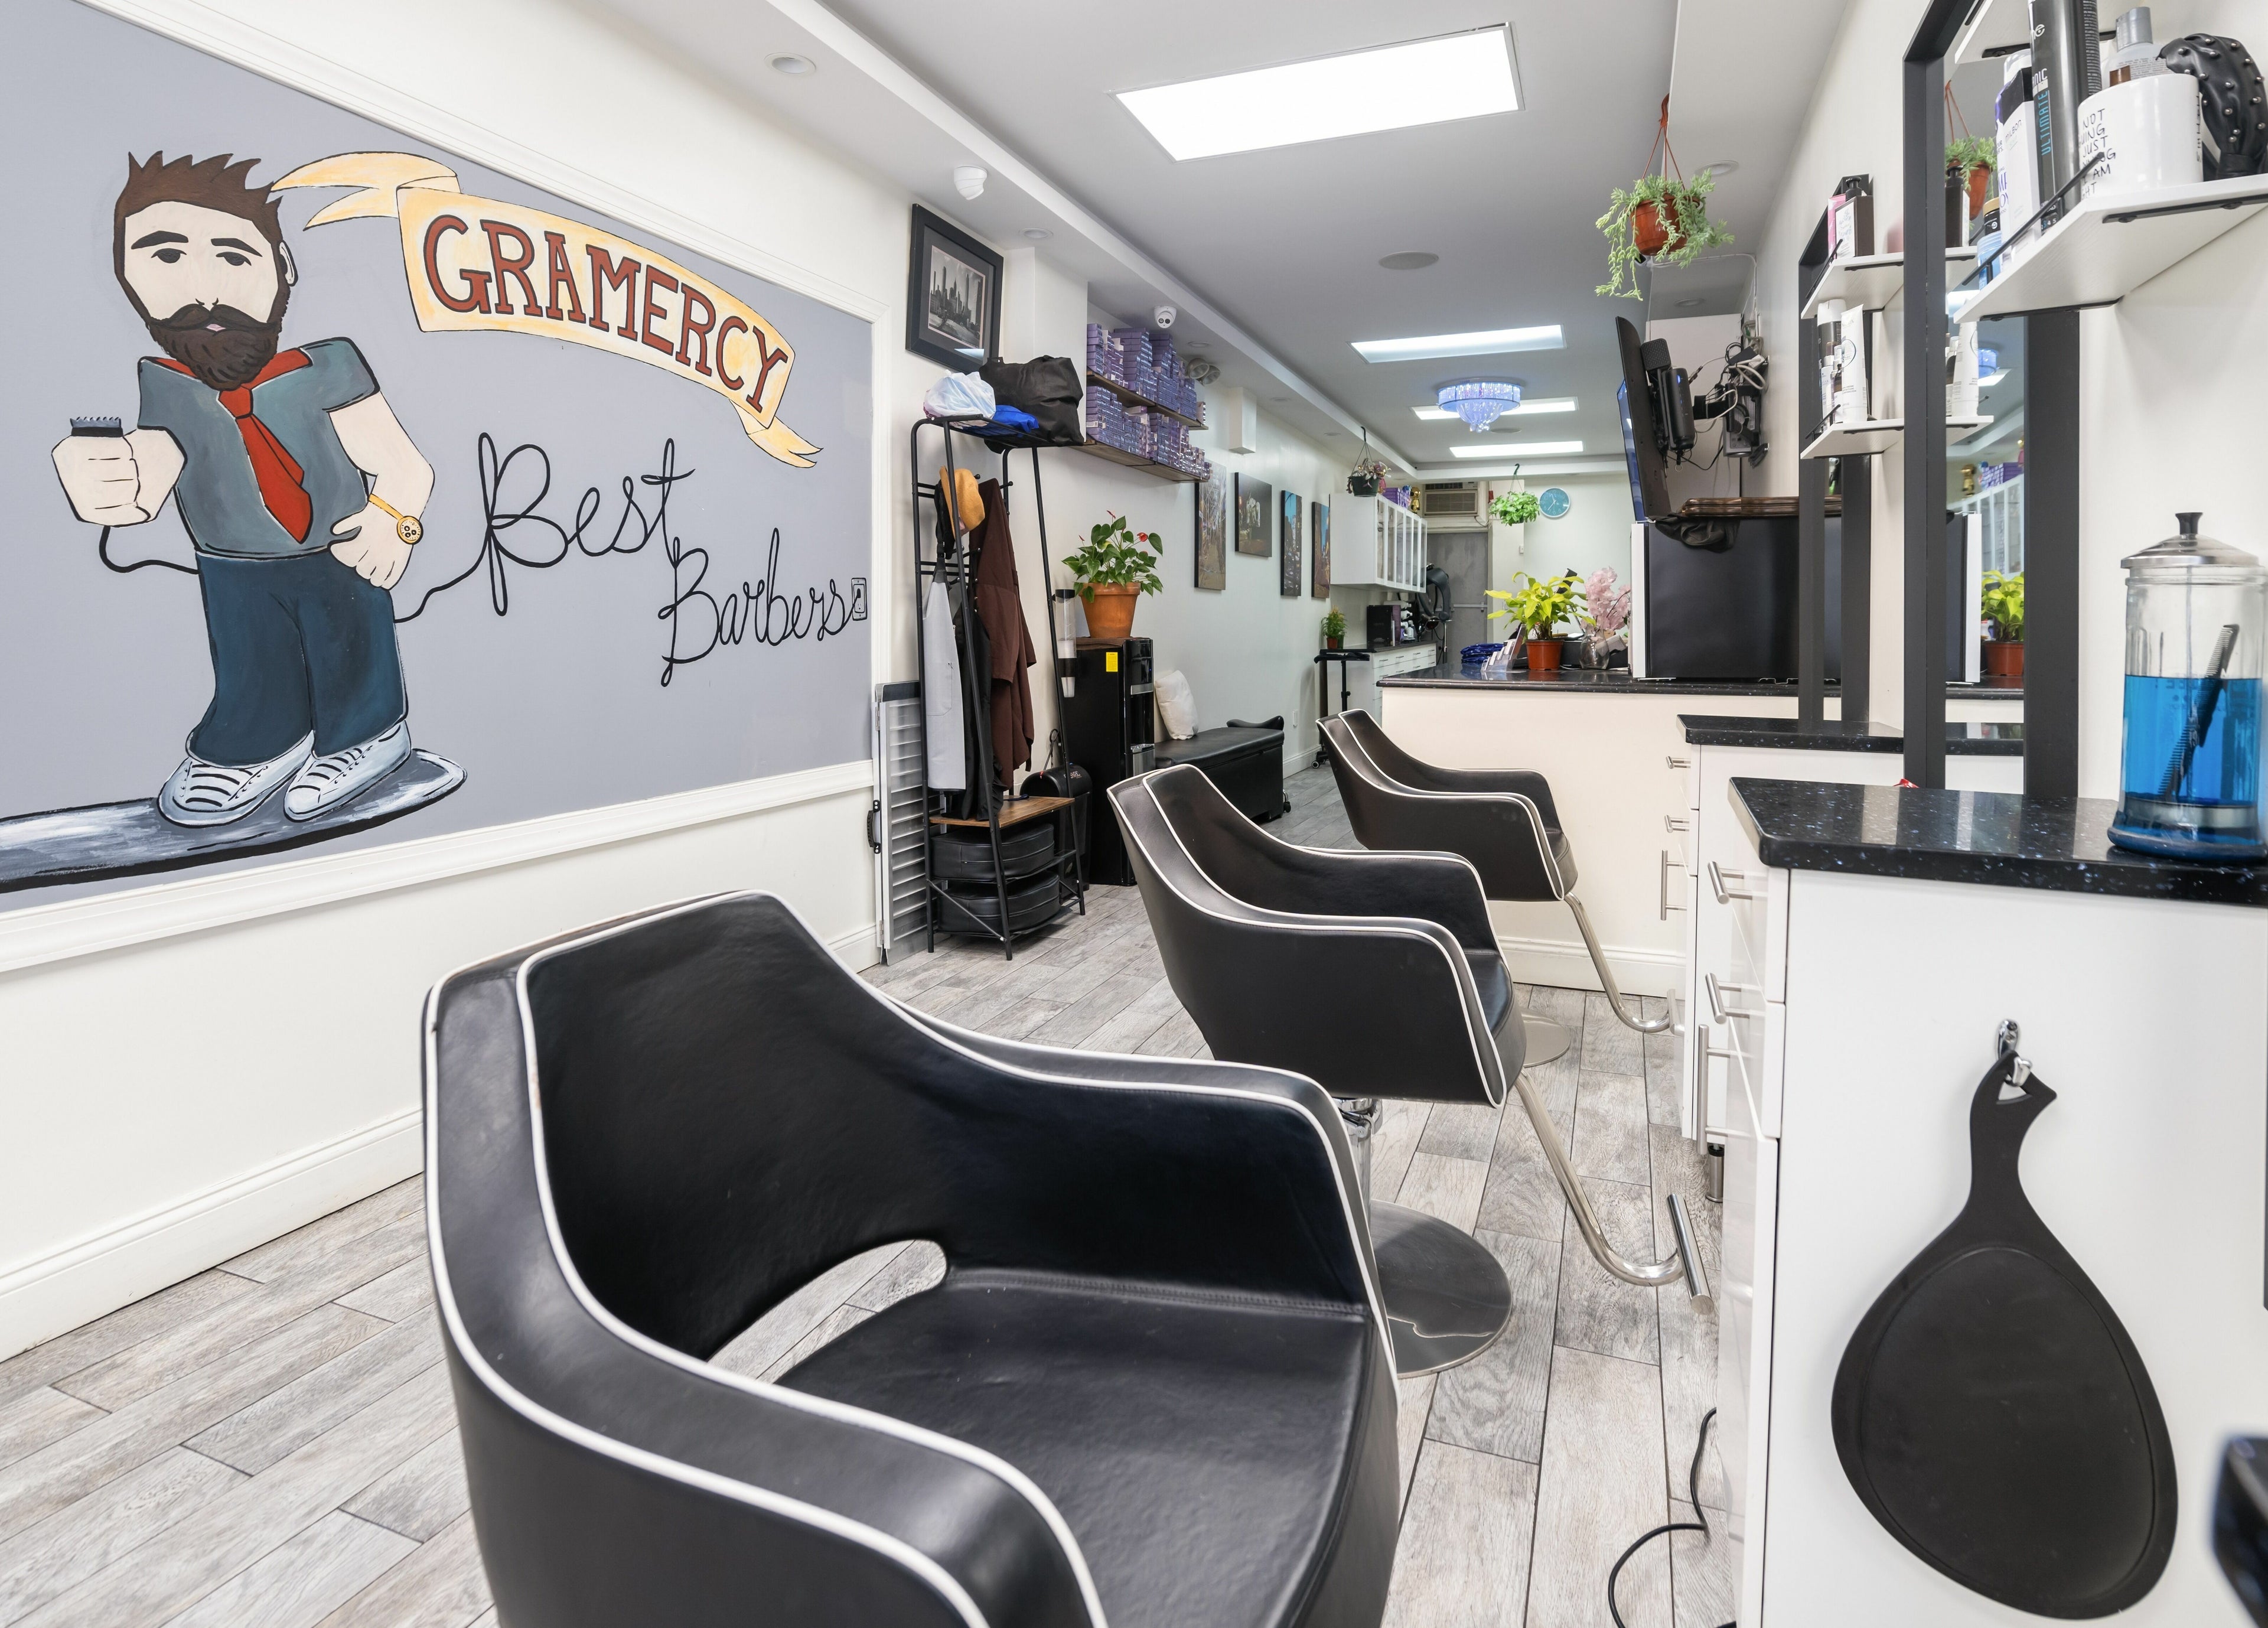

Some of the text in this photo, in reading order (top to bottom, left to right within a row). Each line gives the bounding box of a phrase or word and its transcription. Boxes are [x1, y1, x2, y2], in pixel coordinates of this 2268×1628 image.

[2038, 90, 2051, 155] ULTIMATE
[2080, 123, 2105, 147] UING
[2083, 108, 2105, 131] NOT
[2083, 135, 2108, 158] JUST
[2093, 164, 2111, 180] AM
[423, 214, 788, 413] GRAMERCY
[478, 432, 696, 616] Best
[658, 528, 848, 687] Barbers
